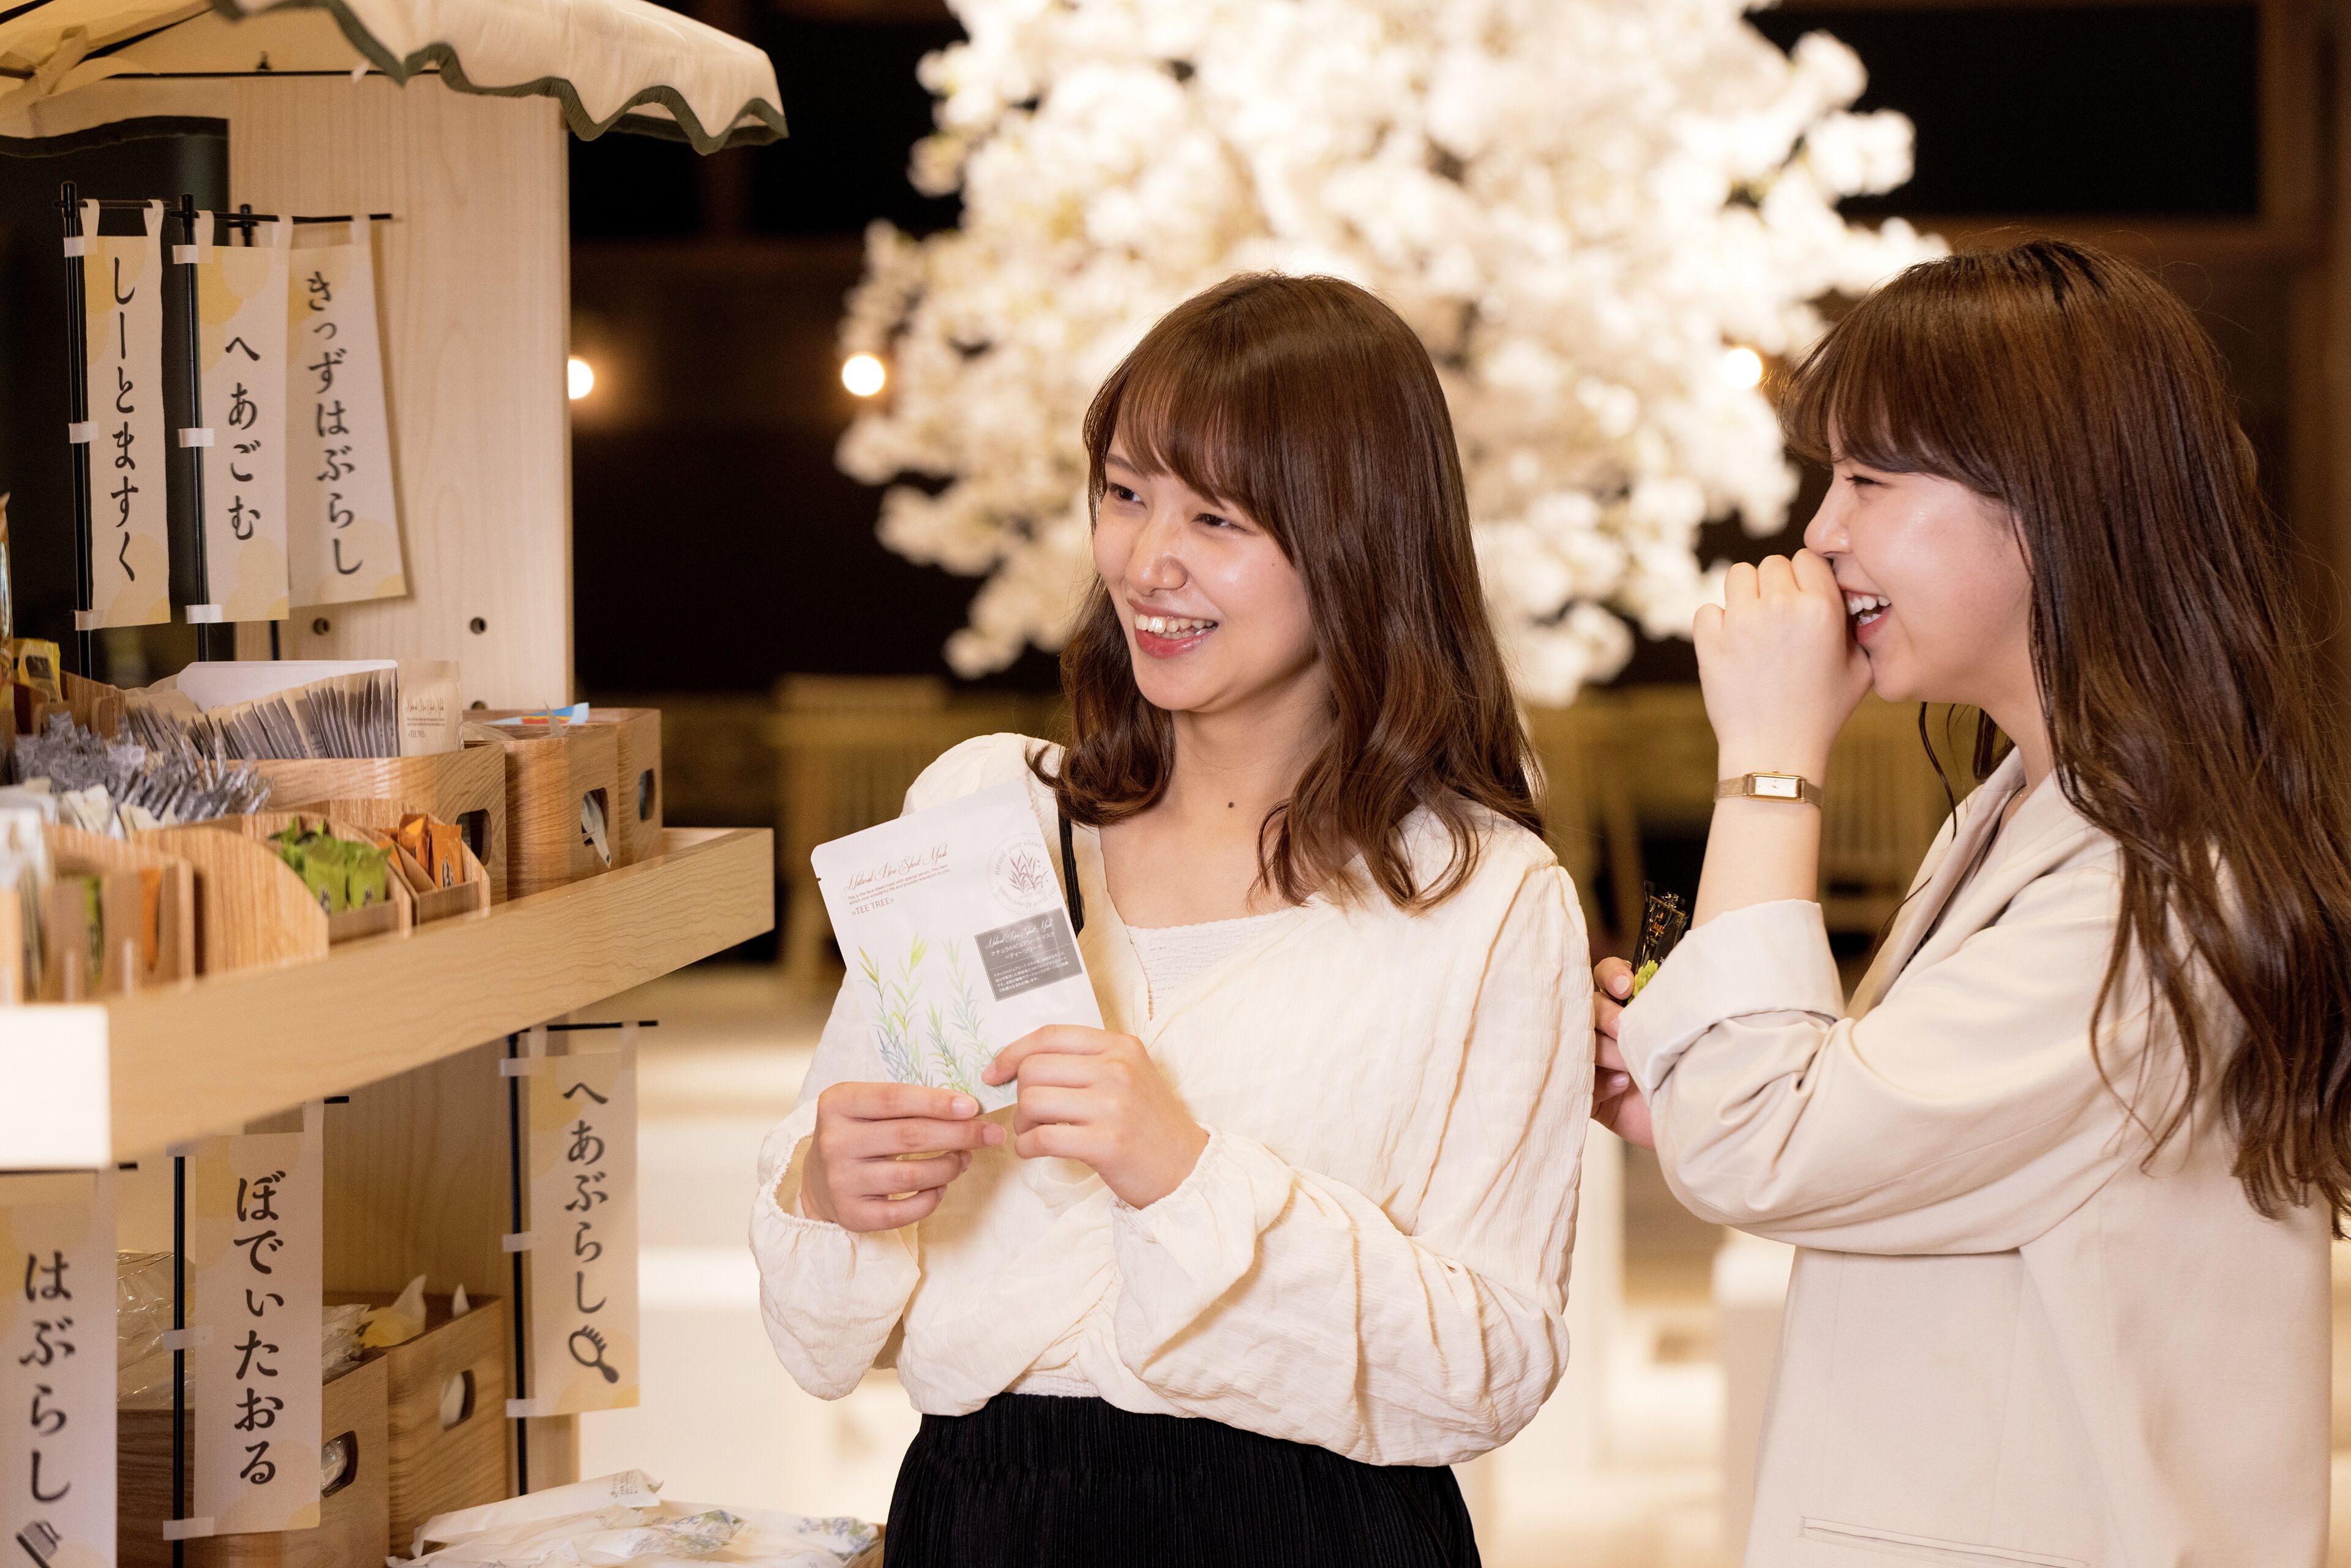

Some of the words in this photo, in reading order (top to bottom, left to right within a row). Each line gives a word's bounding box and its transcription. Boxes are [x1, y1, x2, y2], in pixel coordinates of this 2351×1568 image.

[110, 257, 140, 582] しーとますく
[225, 336, 261, 541] へあごむ
[306, 271, 363, 576] きっずはぶらし
[843, 869, 875, 892] Natural
[874, 861, 897, 880] Pure
[898, 854, 922, 875] Sheet
[923, 842, 948, 865] Mask
[562, 1082, 609, 1315] へあぶらし
[19, 1250, 76, 1503] はぶらし
